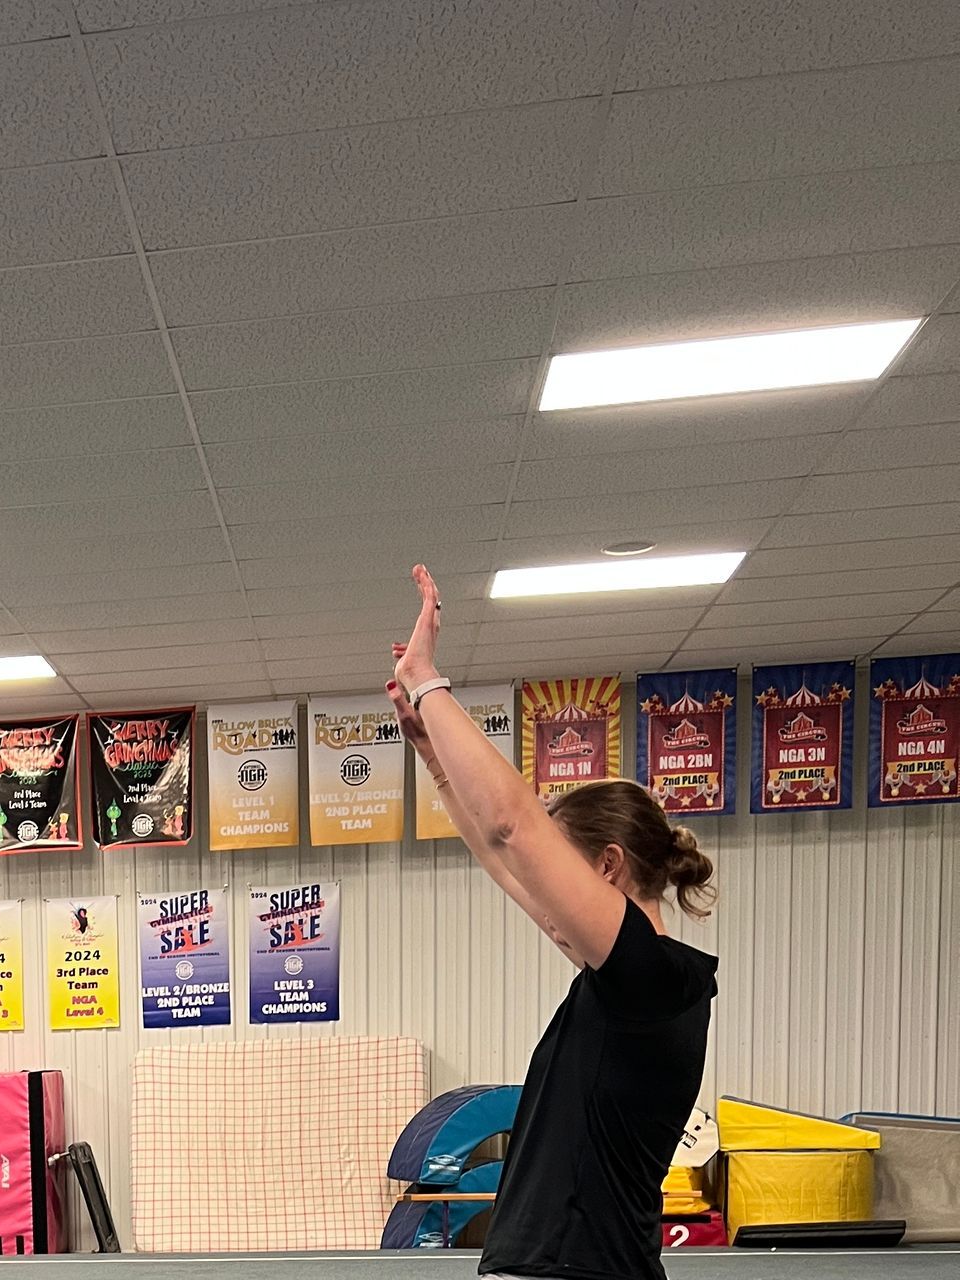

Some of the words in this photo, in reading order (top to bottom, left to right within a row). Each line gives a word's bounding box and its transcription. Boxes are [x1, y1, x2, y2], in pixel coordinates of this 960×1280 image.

[469, 703, 507, 716] BRICK
[211, 720, 256, 732] YELLOW
[258, 717, 293, 729] BRICK
[314, 715, 360, 727] YELLOW
[362, 712, 397, 724] BRICK
[114, 720, 170, 740] MERRY
[1, 728, 55, 748] MERRY
[213, 729, 273, 756] ROAD
[315, 724, 376, 750] ROAD
[898, 742, 925, 756] NGA
[927, 740, 945, 754] 4N
[779, 748, 805, 763] NGA
[808, 747, 826, 761] 3N
[659, 756, 685, 770] NGA
[687, 754, 713, 768] 2BN
[897, 763, 915, 773] 2nd
[917, 760, 945, 772] PLACE
[240, 769, 265, 782] NGA
[343, 764, 368, 777] NGA
[550, 762, 575, 777] NGA
[576, 761, 592, 775] 1N
[779, 770, 796, 780] 2nd
[798, 768, 825, 779] PLACE
[663, 776, 681, 786] 2nd
[682, 774, 708, 785] PLACE
[549, 783, 564, 793] 3rd
[31, 800, 47, 808] Team
[144, 795, 162, 803] Team
[233, 797, 265, 808] LEVEL
[269, 797, 274, 806] 1
[311, 793, 339, 805] LEVEL
[238, 810, 270, 821] TEAM
[325, 806, 349, 817] 2ND
[353, 804, 388, 816] PLACE
[220, 822, 289, 837] CHAMPIONS
[340, 819, 372, 830] TEAM
[160, 890, 209, 919] SUPER
[270, 884, 320, 913] SUPER
[150, 907, 210, 928] GYMNASTICS
[259, 901, 321, 921] GYMNASTICS
[160, 920, 210, 954] SALE
[270, 915, 320, 948] SALE
[64, 950, 101, 962] 2024
[56, 968, 76, 977] 3rd
[79, 967, 109, 977] Place
[67, 980, 98, 990] Team
[142, 987, 170, 998] LEVEL
[173, 982, 229, 995] 2/BRONZE
[274, 981, 304, 990] LEVEL
[307, 980, 314, 989] 3
[72, 995, 97, 1005] NGA
[157, 998, 179, 1008] 2ND
[182, 995, 214, 1006] PLACE
[279, 991, 309, 1002] TEAM
[1, 1010, 9, 1018] 3
[66, 1008, 95, 1017] Level
[97, 1007, 105, 1015] 4
[171, 1008, 201, 1018] TEAM
[262, 1002, 327, 1015] CHAMPIONS
[669, 1225, 690, 1247] 2
